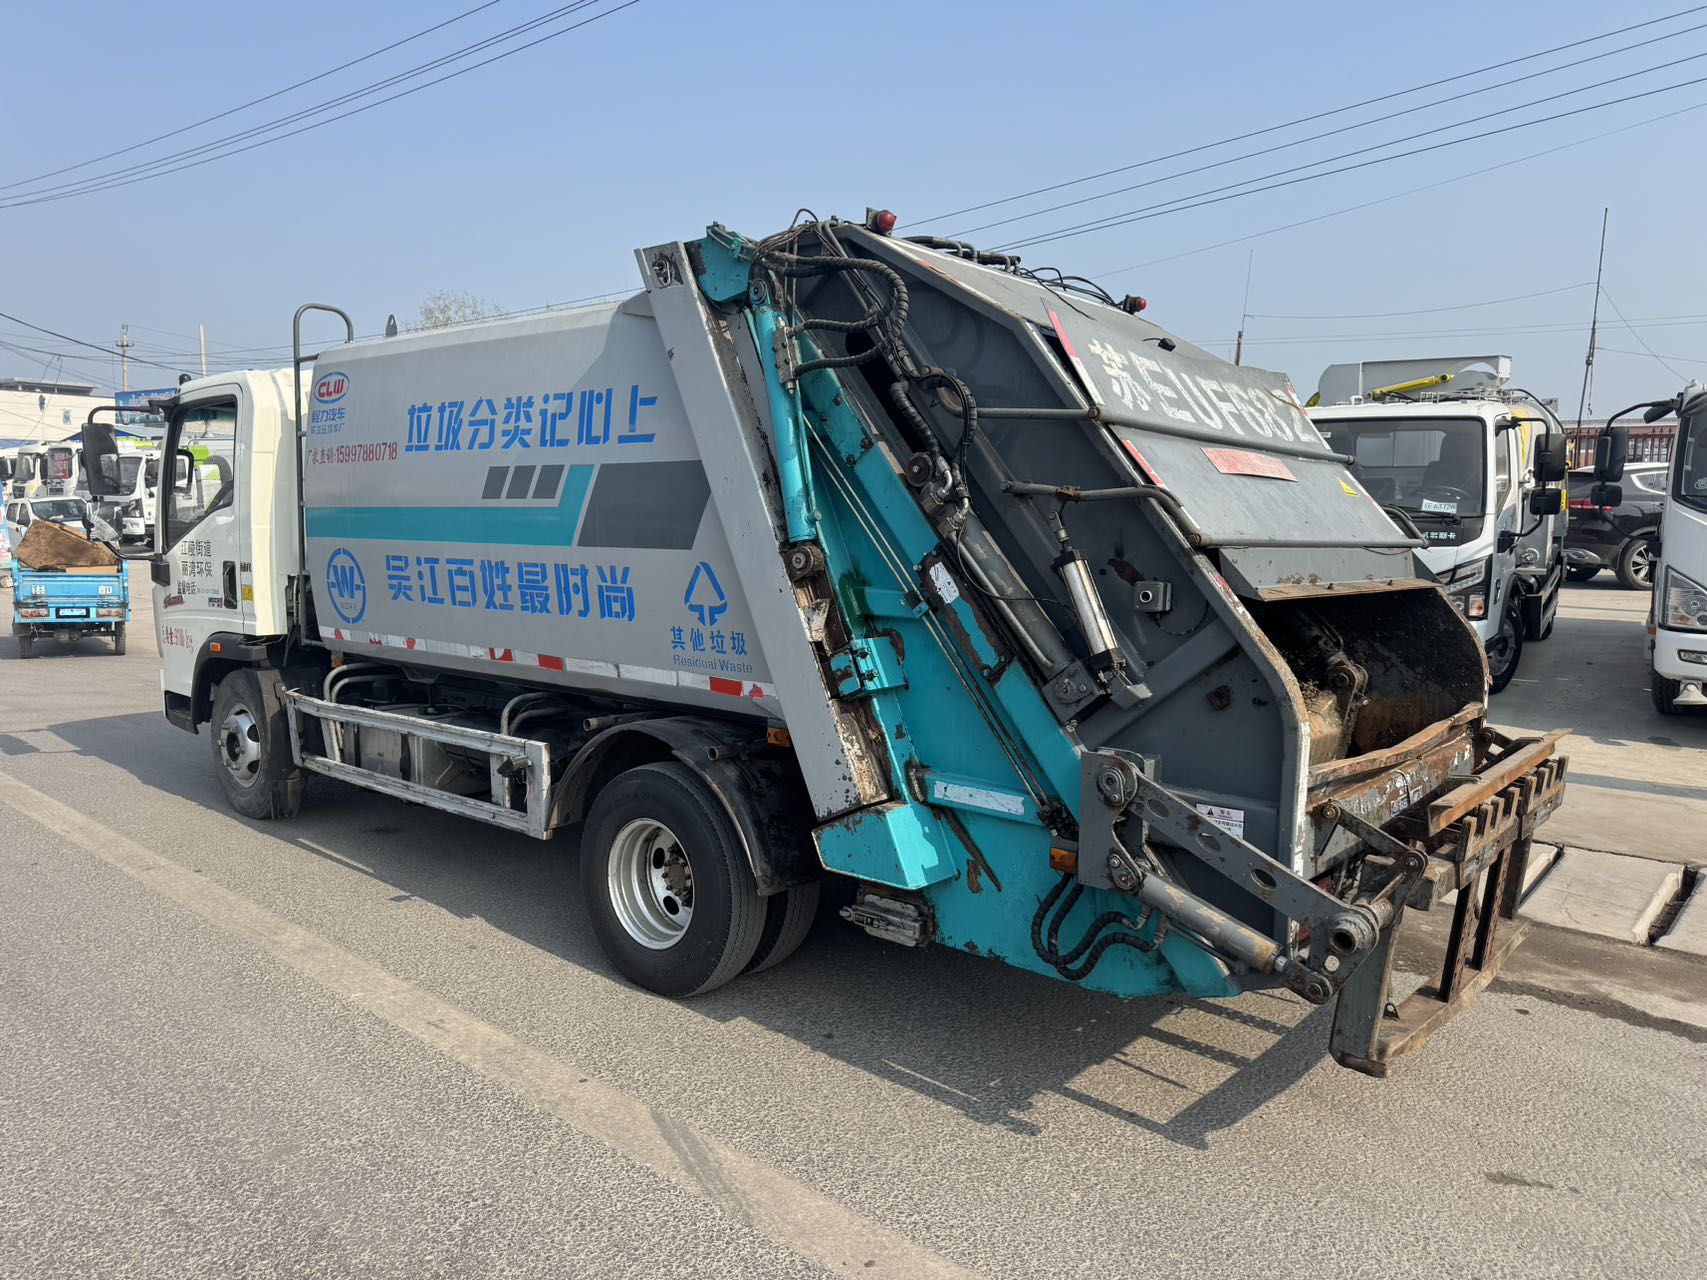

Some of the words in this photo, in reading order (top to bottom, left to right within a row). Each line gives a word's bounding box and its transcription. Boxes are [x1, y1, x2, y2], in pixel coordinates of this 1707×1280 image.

[318, 379, 344, 398] CLW
[405, 385, 657, 452] 垃圾分类记心上
[385, 554, 636, 622] 吴江百姓最时尚
[670, 626, 748, 656] 其他垃圾
[673, 654, 717, 670] Residual
[718, 659, 753, 674] Waste
